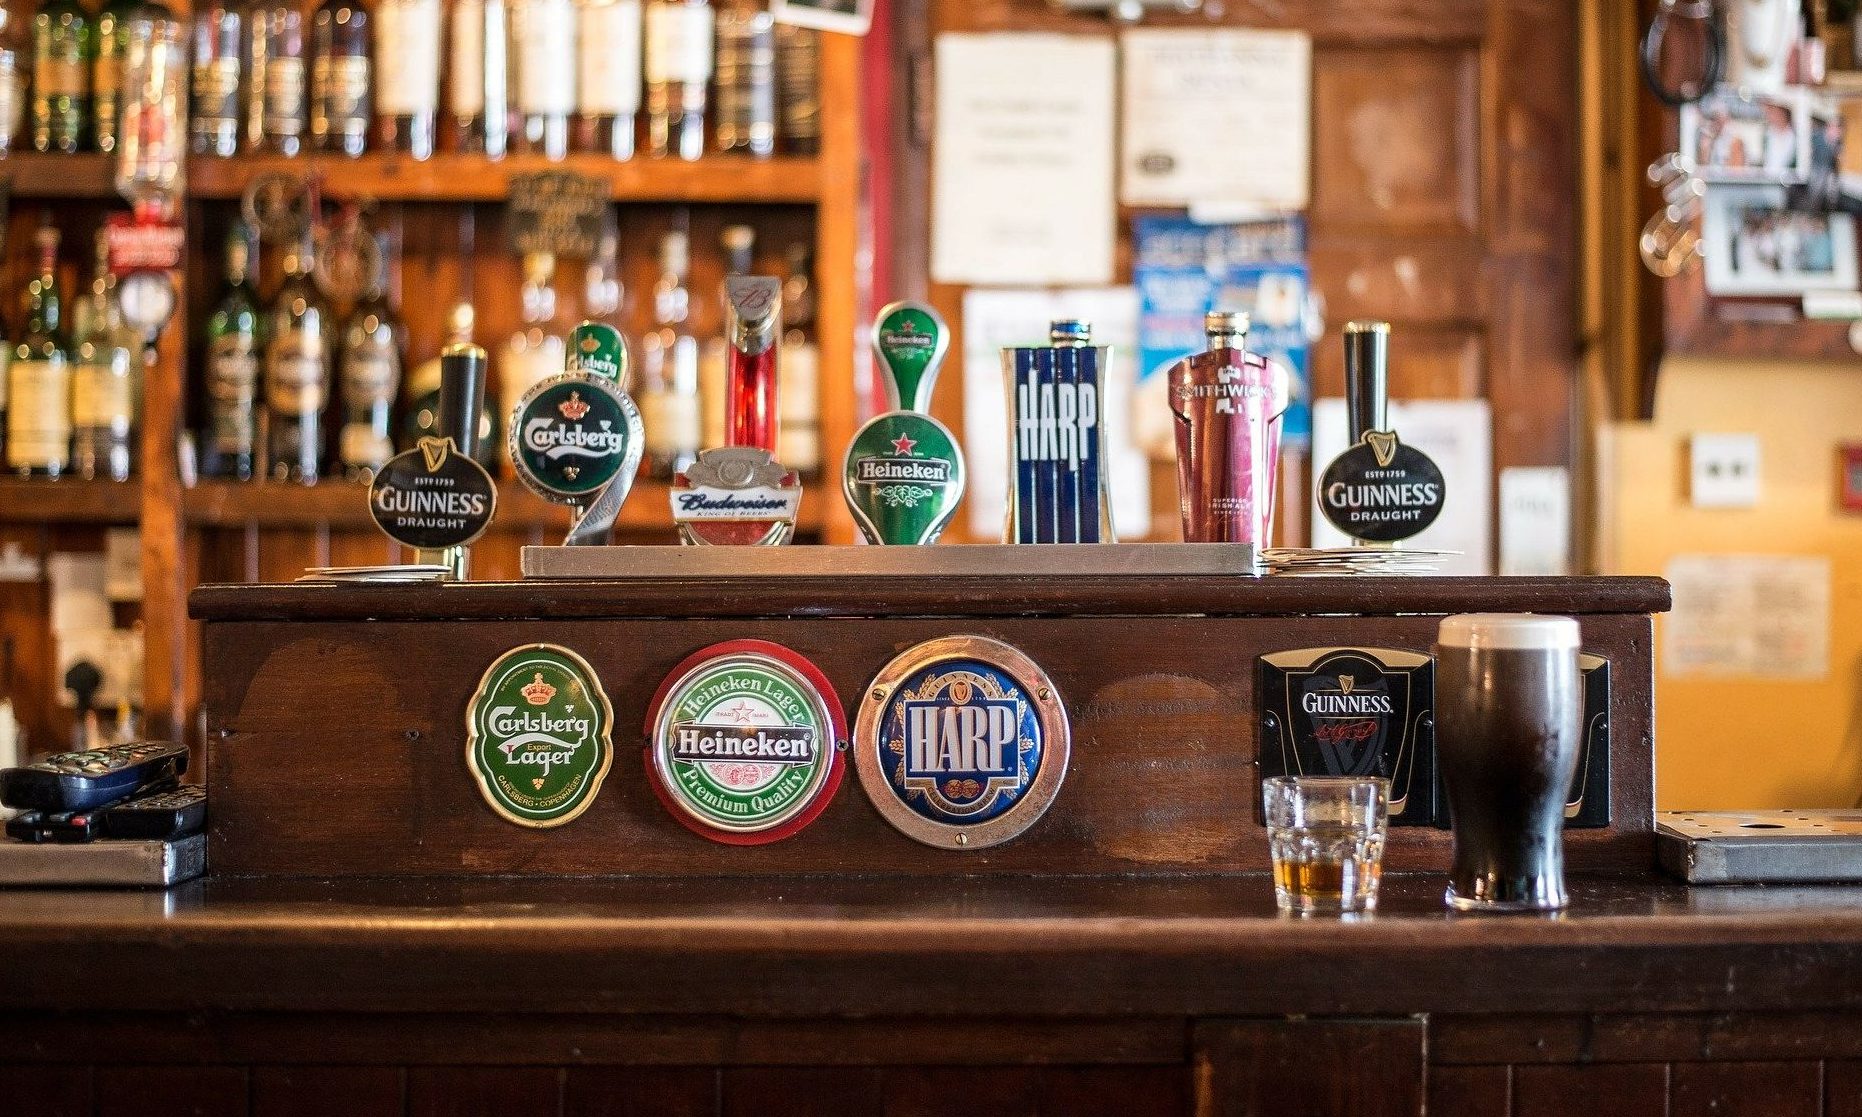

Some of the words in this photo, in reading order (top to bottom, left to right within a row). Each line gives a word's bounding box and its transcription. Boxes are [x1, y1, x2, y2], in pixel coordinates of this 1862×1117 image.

[887, 336, 930, 345] Heineken
[572, 354, 617, 379] lsberg
[1019, 369, 1097, 471] HARP
[524, 417, 624, 456] Carlsberg
[863, 462, 945, 480] Heineken
[1386, 470, 1406, 478] 1759
[379, 486, 484, 515] GUINNESS
[679, 493, 788, 511] Budweiser
[1328, 482, 1438, 508] GUINNESS
[398, 517, 466, 529] DRAUGHT
[1351, 511, 1421, 521] DRAUGHT
[929, 673, 993, 697] GUINNESS
[683, 676, 761, 718] Heineken
[765, 679, 805, 721] Lager
[1302, 692, 1392, 713] GUINNESS
[489, 706, 590, 738] Carlsberg
[527, 743, 552, 751] Export
[679, 729, 810, 757] Heineken
[909, 706, 1016, 772] HARP
[505, 744, 575, 777] Lager
[498, 774, 533, 807] CARLSBERG
[540, 773, 582, 807] COPENHAGEN
[682, 769, 748, 813] Premium
[751, 769, 805, 813] Quality
